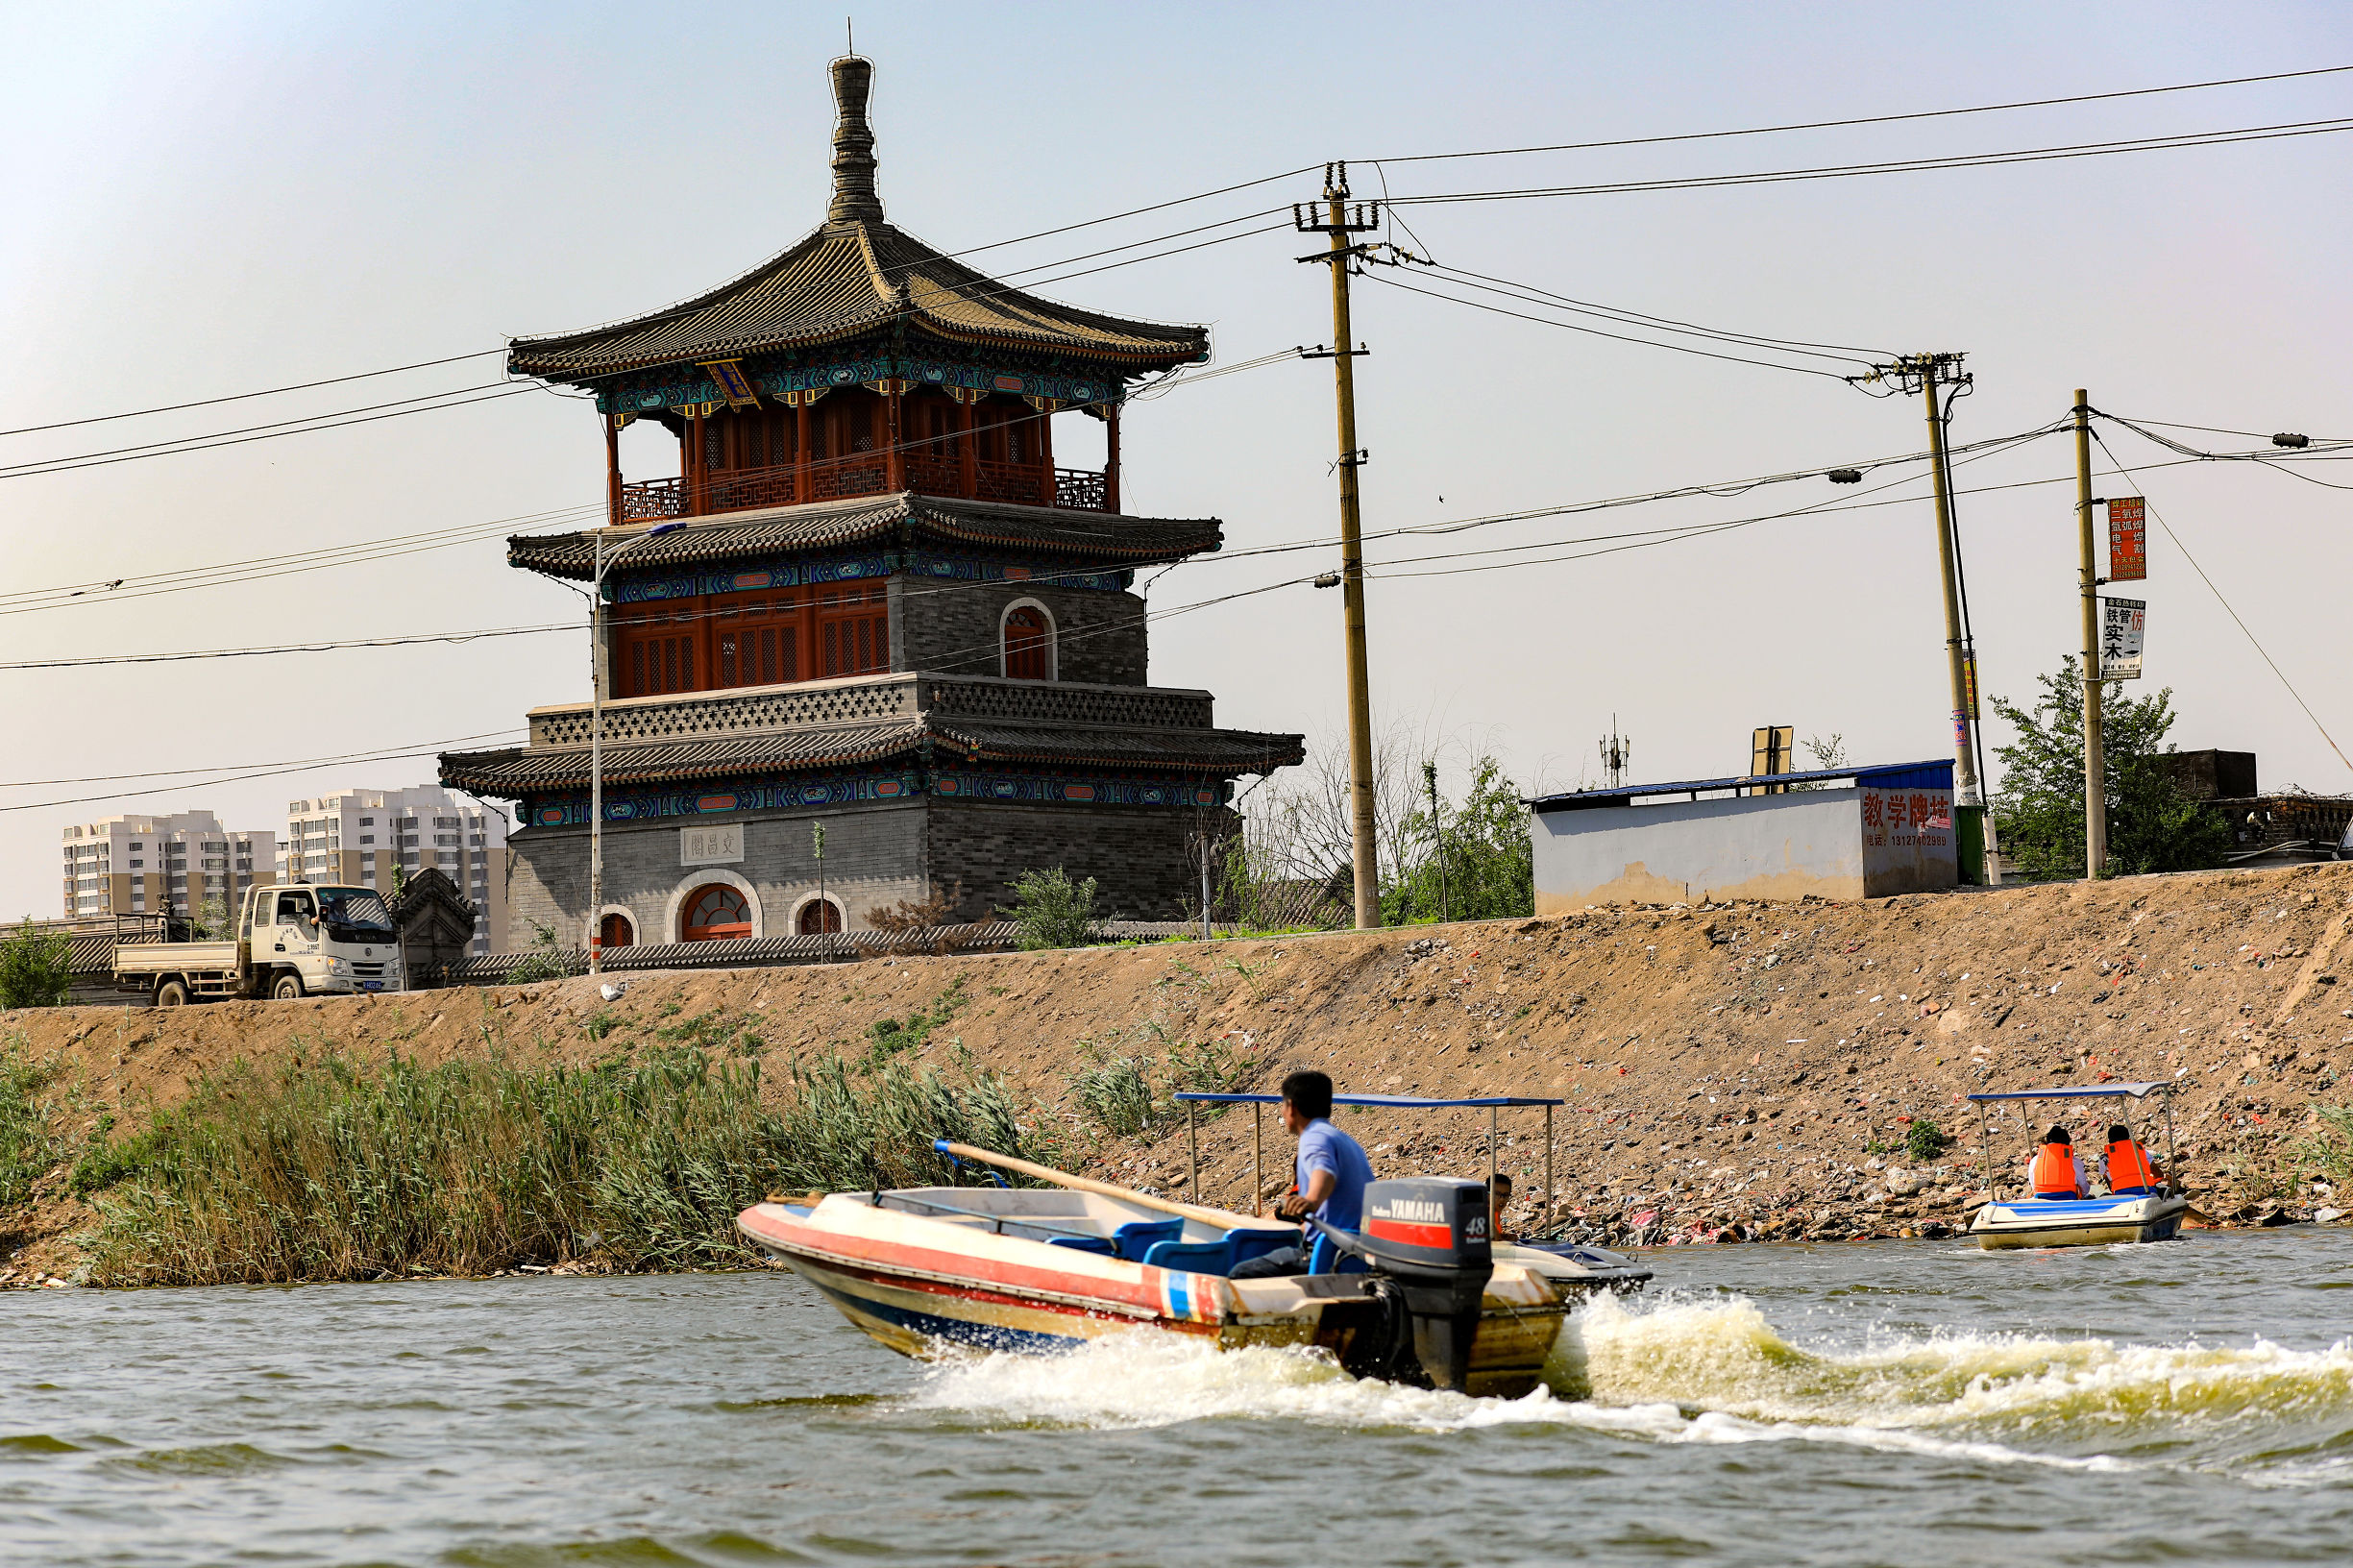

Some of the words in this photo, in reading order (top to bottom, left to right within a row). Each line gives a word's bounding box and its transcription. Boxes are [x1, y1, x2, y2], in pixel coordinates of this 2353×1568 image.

[2111, 508, 2144, 520] 二氧焊
[2111, 520, 2144, 531] 氩弧焊
[1390, 1198, 1445, 1223] YAMAHA
[1465, 1216, 1486, 1236] 48
